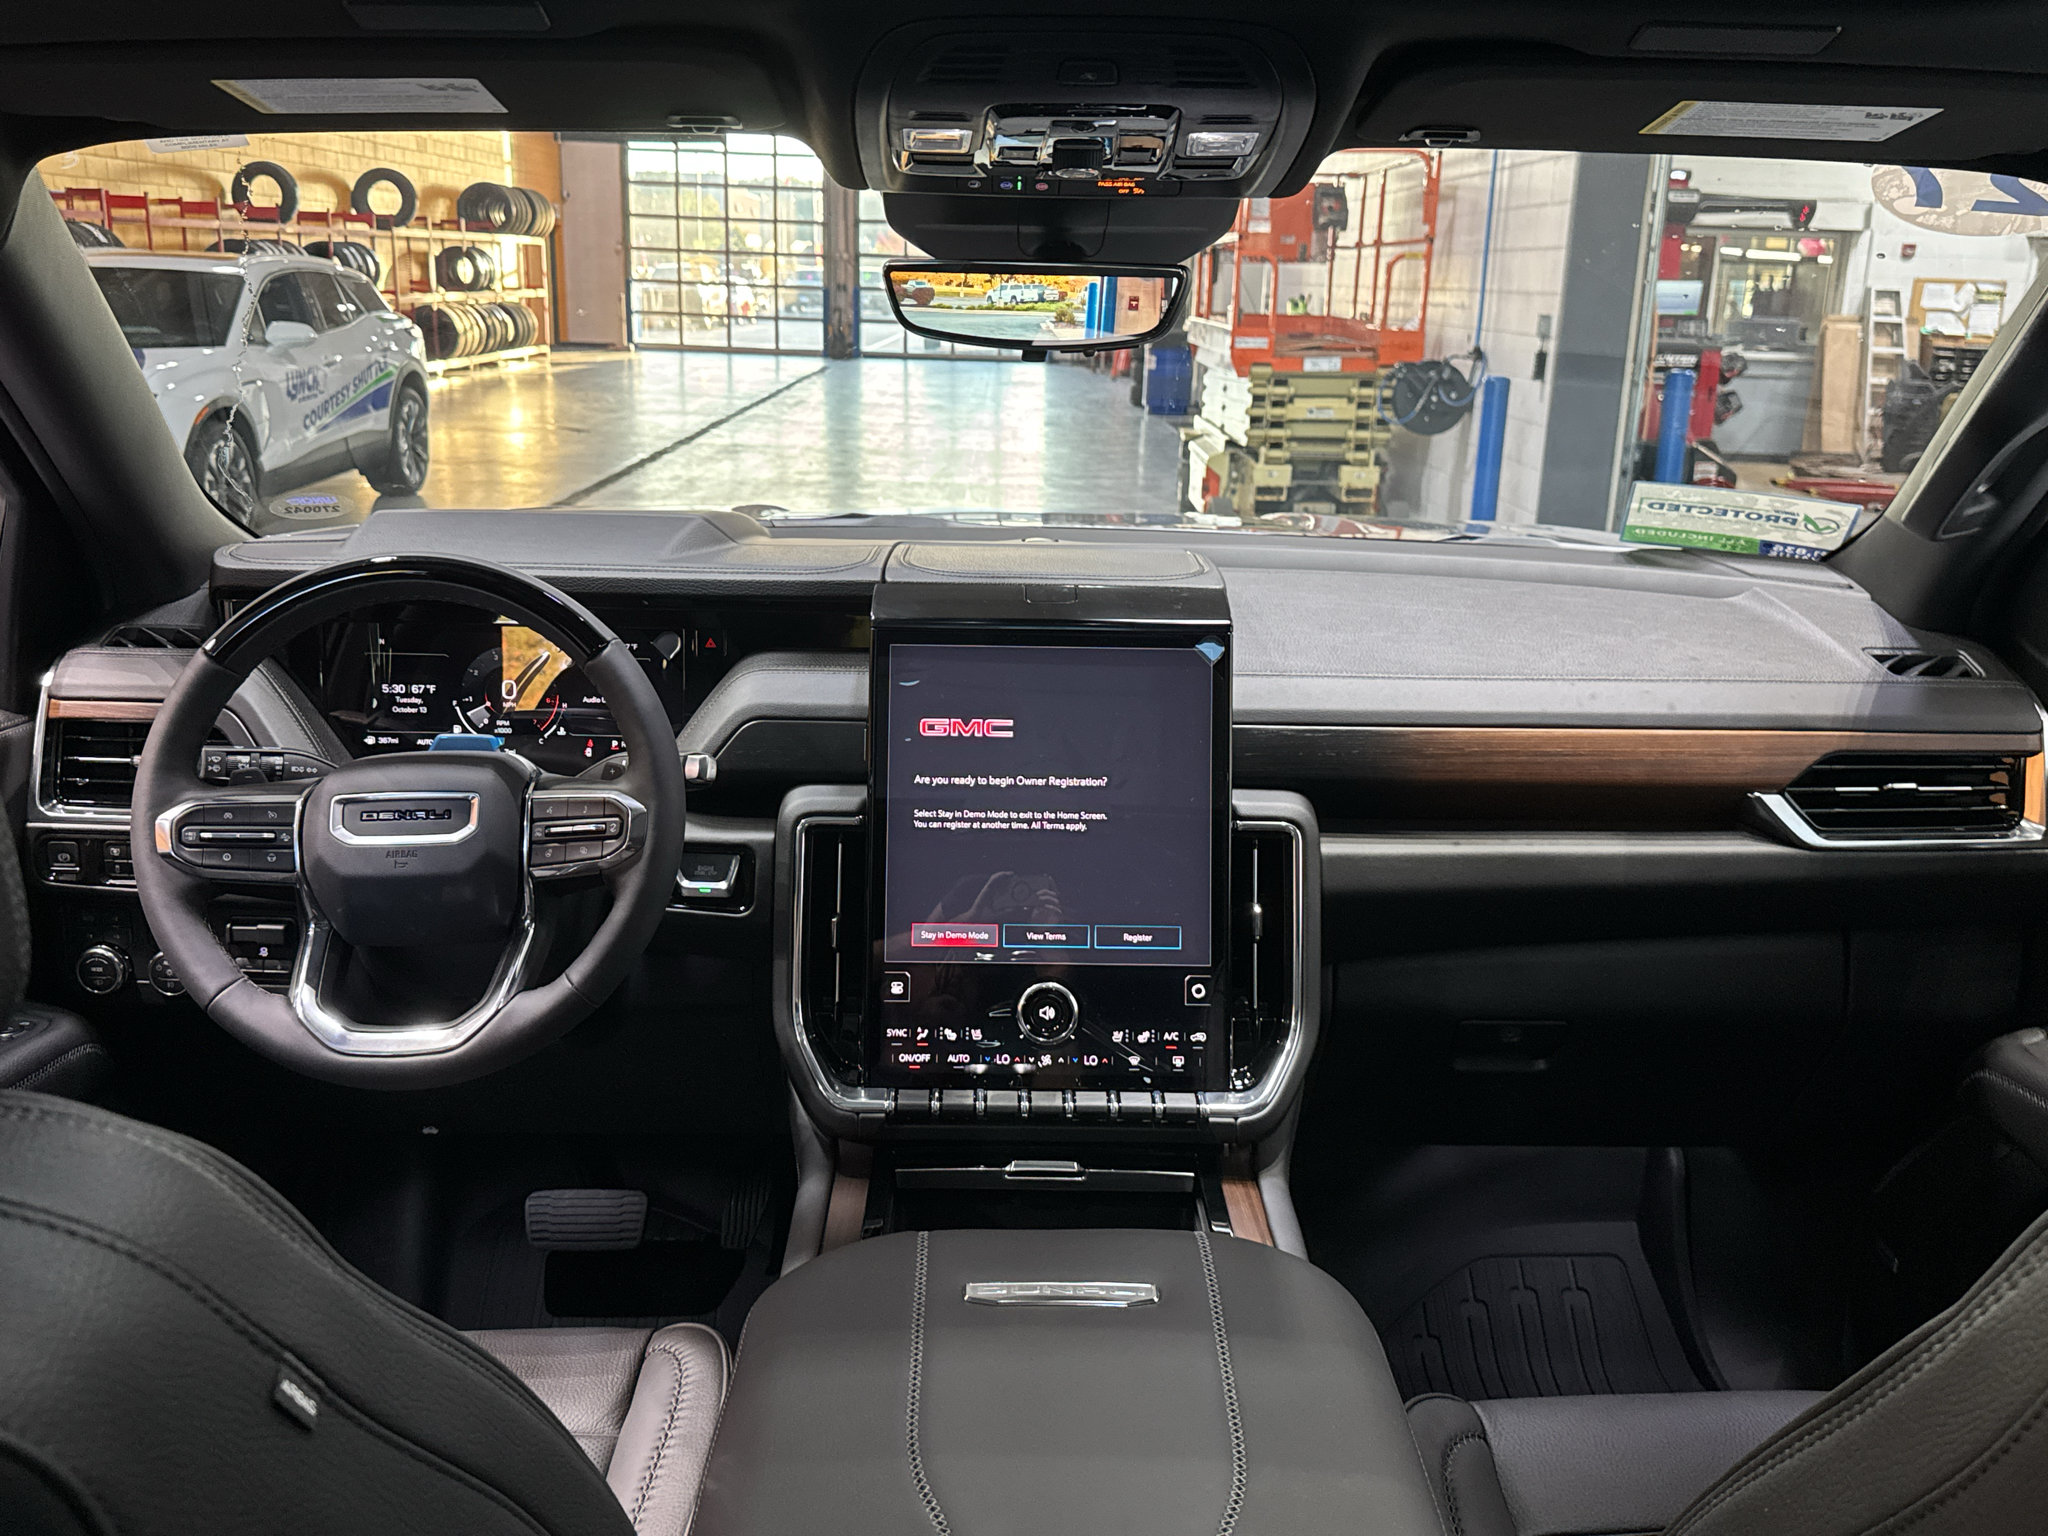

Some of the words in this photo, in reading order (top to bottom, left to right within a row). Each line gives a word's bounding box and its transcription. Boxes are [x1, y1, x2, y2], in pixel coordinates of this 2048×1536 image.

[303, 380, 352, 430] COURTESY
[381, 683, 406, 694] 5:30
[582, 696, 601, 704] Audio
[392, 706, 419, 714] October
[919, 717, 1014, 738] GMC
[914, 774, 930, 784] Are
[932, 776, 949, 787] you
[951, 774, 976, 787] ready
[977, 776, 987, 785] to
[989, 775, 1014, 788] begin
[1016, 775, 1046, 786] Owner
[1048, 776, 1108, 789] Registration?
[361, 809, 452, 821] DENALI
[913, 809, 936, 818] Select
[938, 809, 954, 820] Stay
[954, 809, 962, 818] in
[963, 809, 986, 818] Demo
[987, 810, 1008, 819] Mode
[1010, 811, 1018, 819] to
[1019, 811, 1033, 819] exit
[1034, 811, 1042, 819] to
[1043, 811, 1056, 819] the
[1057, 811, 1079, 820] Home
[1080, 811, 1108, 820] Screen.
[914, 820, 927, 828] You
[943, 820, 971, 831] register
[972, 821, 980, 829] at
[981, 820, 1010, 829] another
[1011, 821, 1029, 829] time.
[1030, 821, 1041, 829] All
[1042, 821, 1065, 830] Terms
[1065, 821, 1088, 832] apply.
[385, 849, 418, 859] AIRBAG
[921, 930, 936, 940] Stay
[937, 930, 944, 939] in
[945, 930, 967, 939] Demo
[968, 931, 989, 940] Mode
[1026, 932, 1044, 940] View
[1045, 932, 1067, 941] Terms
[1123, 932, 1153, 943] Register
[886, 1028, 907, 1038] SYNC
[1163, 1031, 1179, 1041] A/C
[898, 1053, 931, 1063] ON/OFF
[947, 1053, 970, 1063] AUTO
[996, 1053, 1011, 1064] LO
[1083, 1055, 1098, 1066] LO
